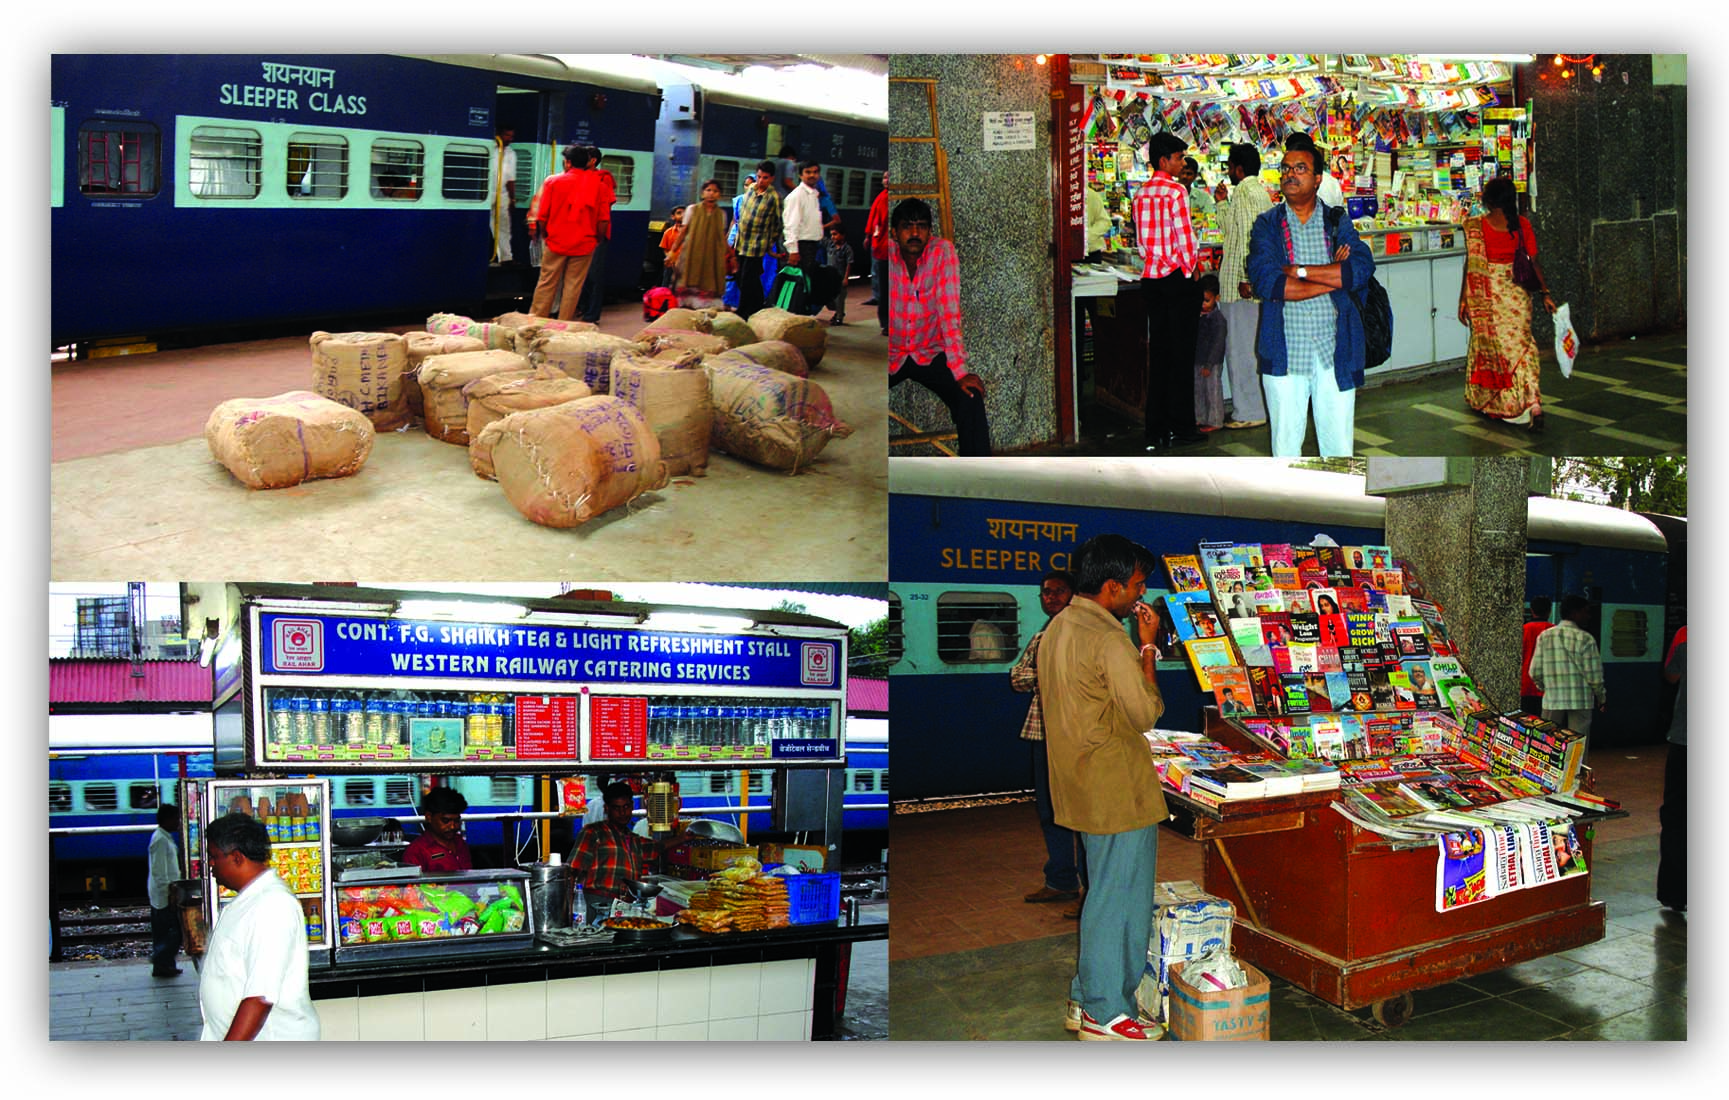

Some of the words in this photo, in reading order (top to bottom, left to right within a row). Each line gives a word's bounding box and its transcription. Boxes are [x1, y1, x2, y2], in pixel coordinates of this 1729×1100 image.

[261, 62, 336, 89] शयनयान
[219, 84, 299, 110] SLEEPER
[309, 92, 367, 115] CLASS
[987, 518, 1078, 542] शयनयान
[941, 548, 1042, 571] SLEEPER
[1347, 614, 1374, 622] WINK
[336, 622, 394, 641] CONT.
[399, 624, 434, 643] F.G.
[441, 626, 510, 647] SHAIKH
[514, 630, 550, 648] TEA
[556, 632, 567, 648] &
[574, 632, 622, 651] LIGHT
[628, 635, 744, 656] REFRESHMENT
[748, 641, 791, 657] STALL
[1351, 637, 1375, 646] RICH
[391, 653, 489, 674] WESTERN
[496, 656, 579, 677] RAILWAY
[584, 660, 672, 679] CATERING
[677, 663, 750, 681] SERVICES
[1433, 663, 1457, 671] CHILD
[1507, 852, 1517, 887] LETHAL
[1542, 845, 1555, 880] LETHAL
